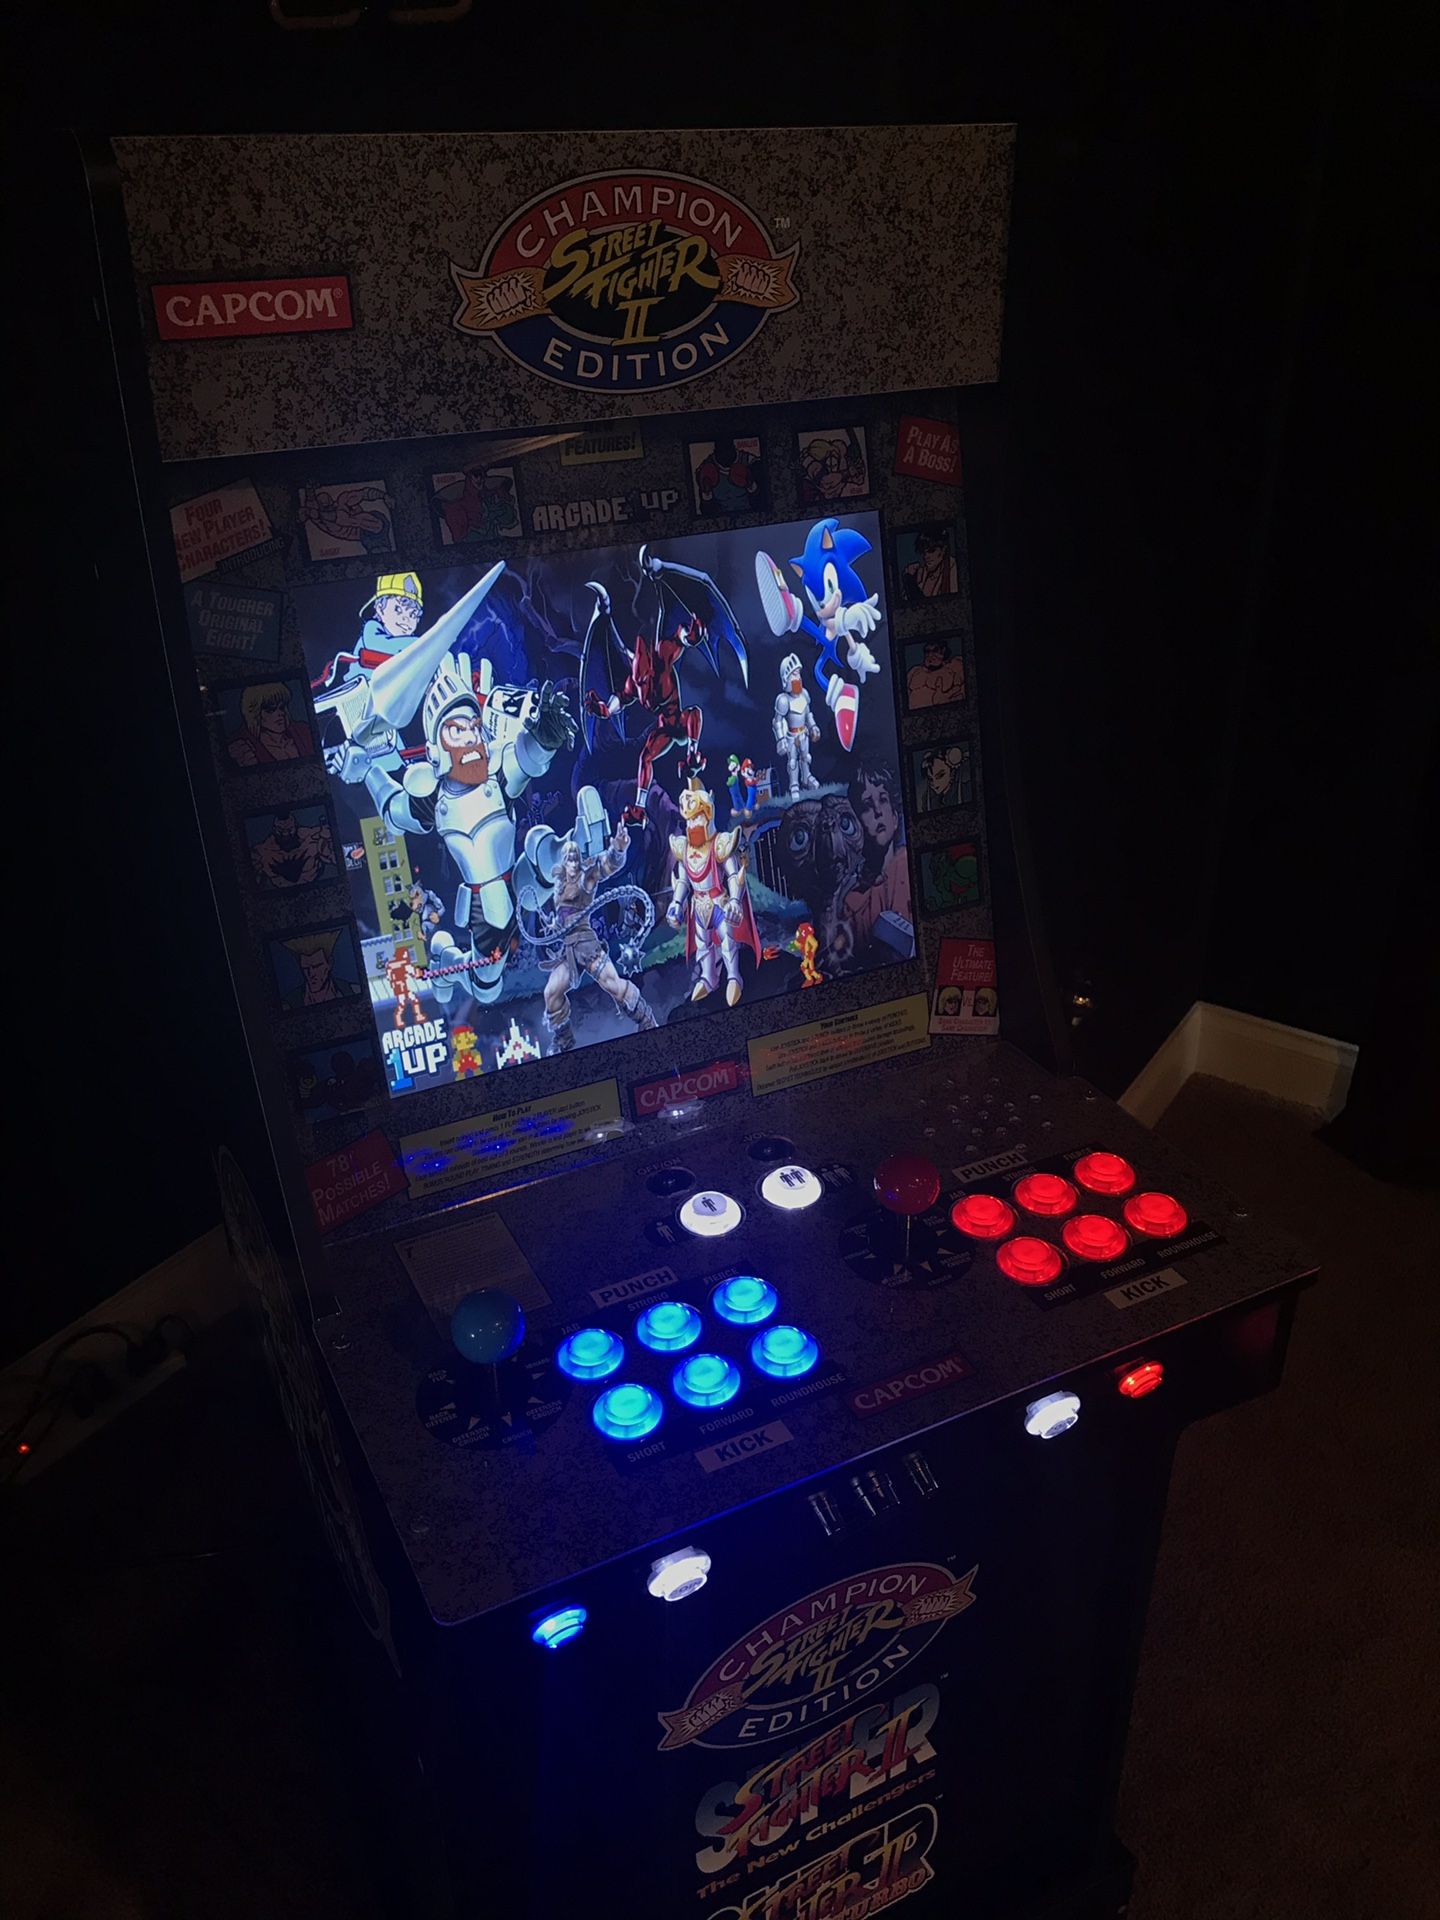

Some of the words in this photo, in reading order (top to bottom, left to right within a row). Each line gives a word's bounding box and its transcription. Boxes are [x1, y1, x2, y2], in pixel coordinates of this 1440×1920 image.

[516, 185, 745, 258] CHAMPION
[542, 218, 663, 303] STREET
[569, 235, 721, 309] FIGHTER
[165, 287, 339, 328] CAPCOM
[542, 321, 731, 382] EDITION
[906, 425, 940, 449] PLAY
[940, 434, 959, 454] AS
[903, 446, 915, 463] A
[917, 448, 958, 473] BOSS!
[184, 499, 224, 526] FOUR
[203, 506, 256, 541] PLAYER
[532, 496, 629, 532] ARCADE
[176, 521, 268, 571] CHARACTERS!
[197, 609, 265, 633] ORIGINAL
[209, 591, 275, 616] TOUGHER
[381, 1018, 448, 1055] ARCADE
[640, 1068, 730, 1108] CAPCOM
[311, 1160, 384, 1207] POSSIBLE
[960, 1153, 1023, 1180] PUNCH
[317, 1172, 391, 1226] MATCHES!
[1158, 1230, 1218, 1259] ROUNDHOUSE
[599, 1270, 674, 1303] PUNCH
[1100, 1257, 1147, 1281] FORWARD
[627, 1290, 670, 1313] STRONG
[1043, 1283, 1077, 1302] SHORT
[1120, 1275, 1171, 1301] KICK
[560, 1322, 582, 1337] JAB
[770, 1372, 847, 1409] ROUNDHOUSE
[854, 1357, 965, 1410] CAPCOM
[699, 1407, 755, 1436] FORWARD
[626, 1440, 668, 1464] SHORT
[714, 1430, 774, 1463] KICK
[719, 1573, 928, 1683] CHAMPION
[742, 1609, 852, 1700] STREET
[737, 1646, 910, 1739] EDITION
[696, 1872, 741, 1900] The
[747, 1839, 801, 1874] New
[804, 1768, 937, 1842] Challengers
